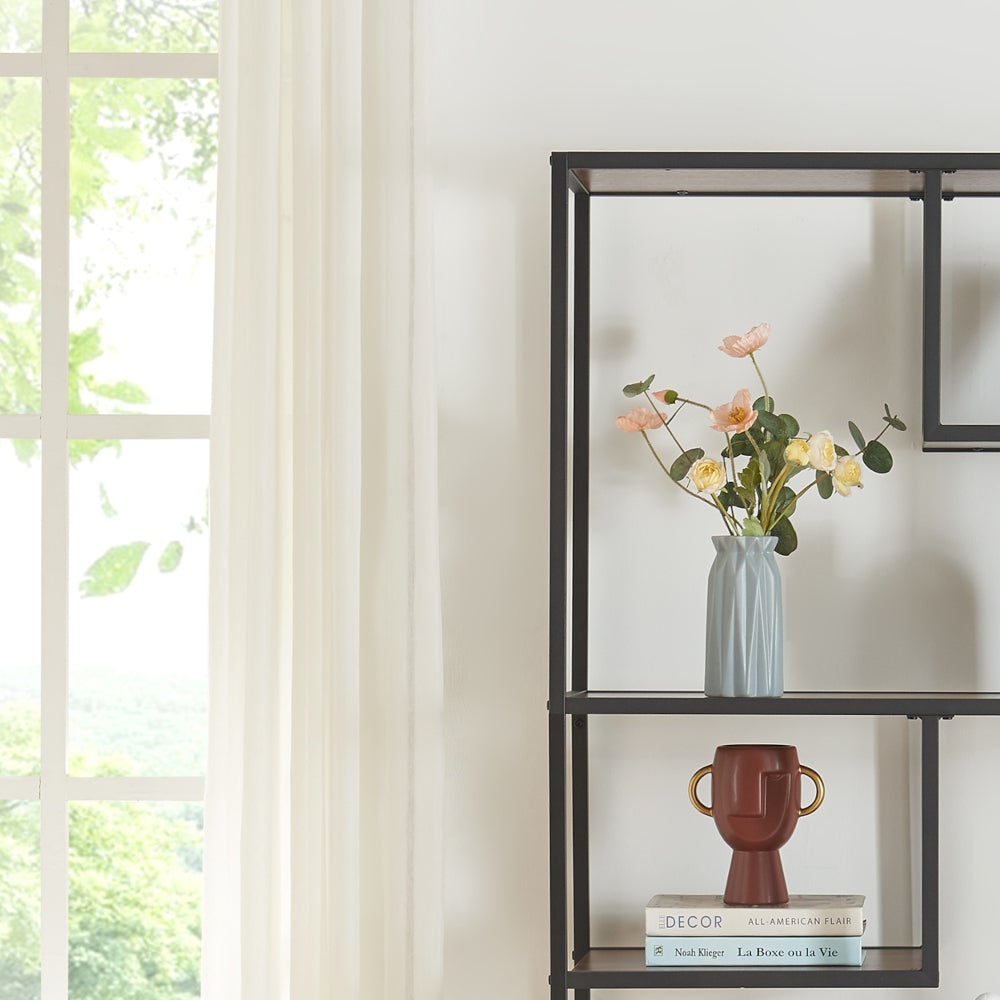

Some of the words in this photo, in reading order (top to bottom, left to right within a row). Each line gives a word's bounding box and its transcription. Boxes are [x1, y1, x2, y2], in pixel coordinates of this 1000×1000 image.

[666, 915, 723, 928] DECOR
[748, 917, 821, 925] ALL-AMERICAN
[824, 917, 852, 926] FLAIR
[674, 948, 696, 957] Noah
[698, 948, 725, 959] Klieger
[737, 948, 752, 957] La
[756, 947, 784, 957] Boxe
[787, 949, 802, 957] ou
[805, 947, 815, 957] la
[819, 947, 839, 957] Vie
